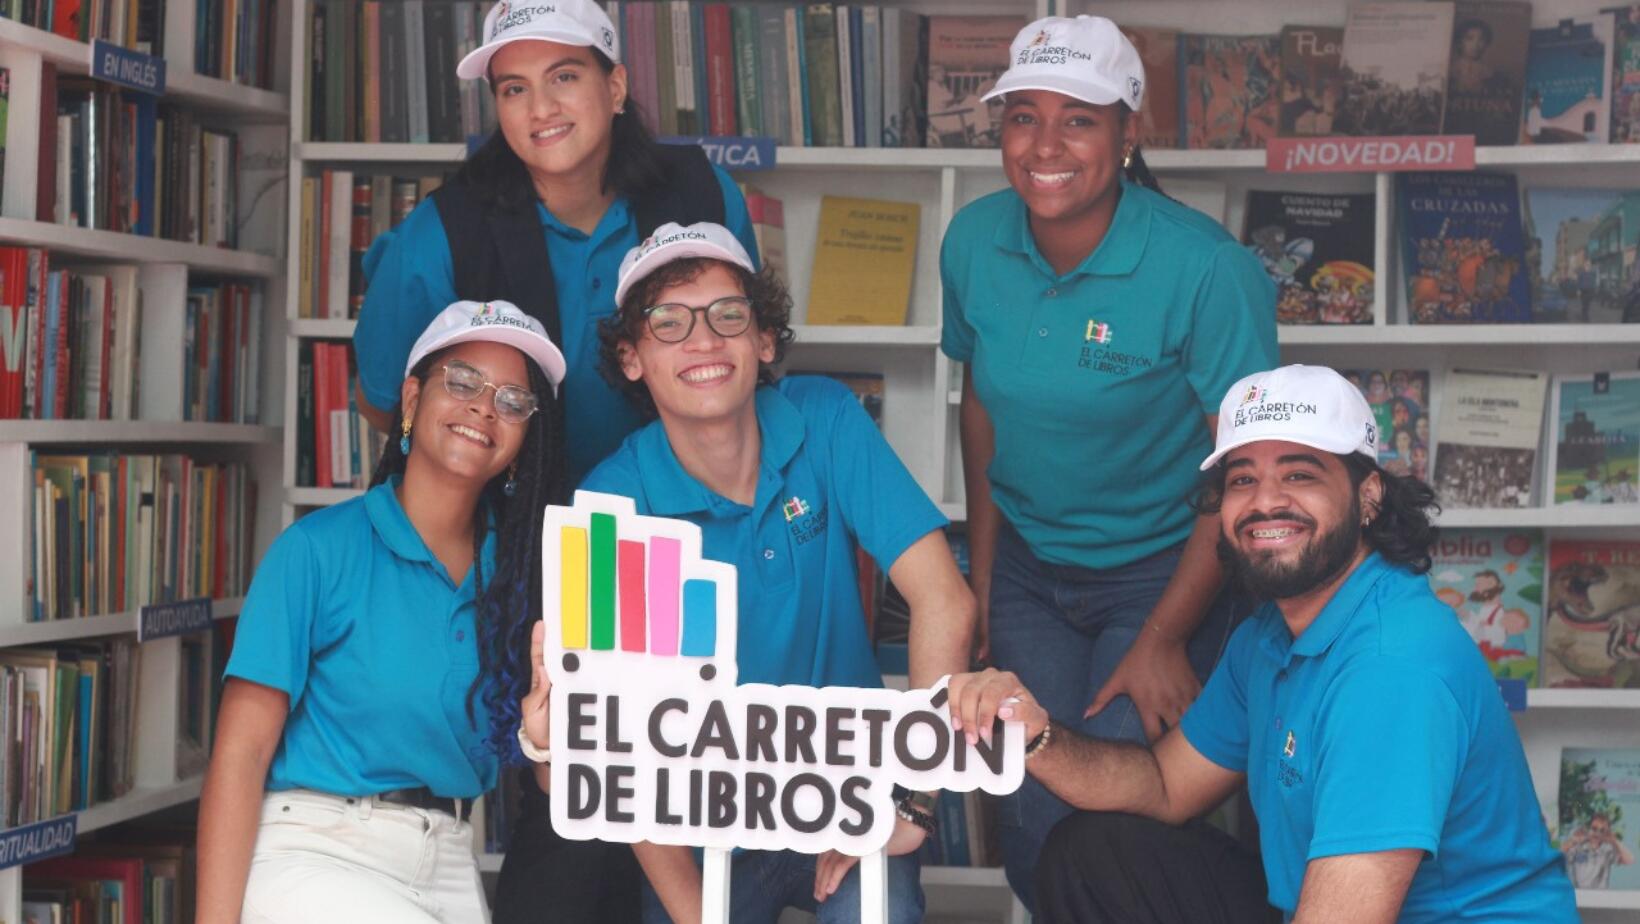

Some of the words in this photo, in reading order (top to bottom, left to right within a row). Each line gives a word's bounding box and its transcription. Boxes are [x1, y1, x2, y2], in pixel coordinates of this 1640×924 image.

[1030, 55, 1067, 65] LIBROS
[1032, 46, 1092, 61] CARRETÓN
[104, 53, 120, 78] EN
[120, 56, 157, 88] INGLÉS
[698, 138, 761, 166] TICA
[1285, 141, 1456, 171] ¡NOVEDAD!
[1285, 206, 1343, 218] NAVIDAD
[1411, 199, 1509, 214] CRUZADAS
[1094, 348, 1153, 367] CARRETÓN
[1094, 360, 1130, 376] LIBROS
[1235, 408, 1246, 419] EL
[1248, 401, 1317, 414] CARRETÓN
[1235, 418, 1247, 427] DE
[1250, 412, 1291, 422] LIBROS
[1432, 535, 1492, 557] iblia
[144, 603, 209, 634] AUTOAYUDA
[567, 692, 634, 753] EL
[648, 686, 1006, 776] CARRETÓN
[567, 762, 636, 824] DE
[655, 765, 876, 838] LIBROS
